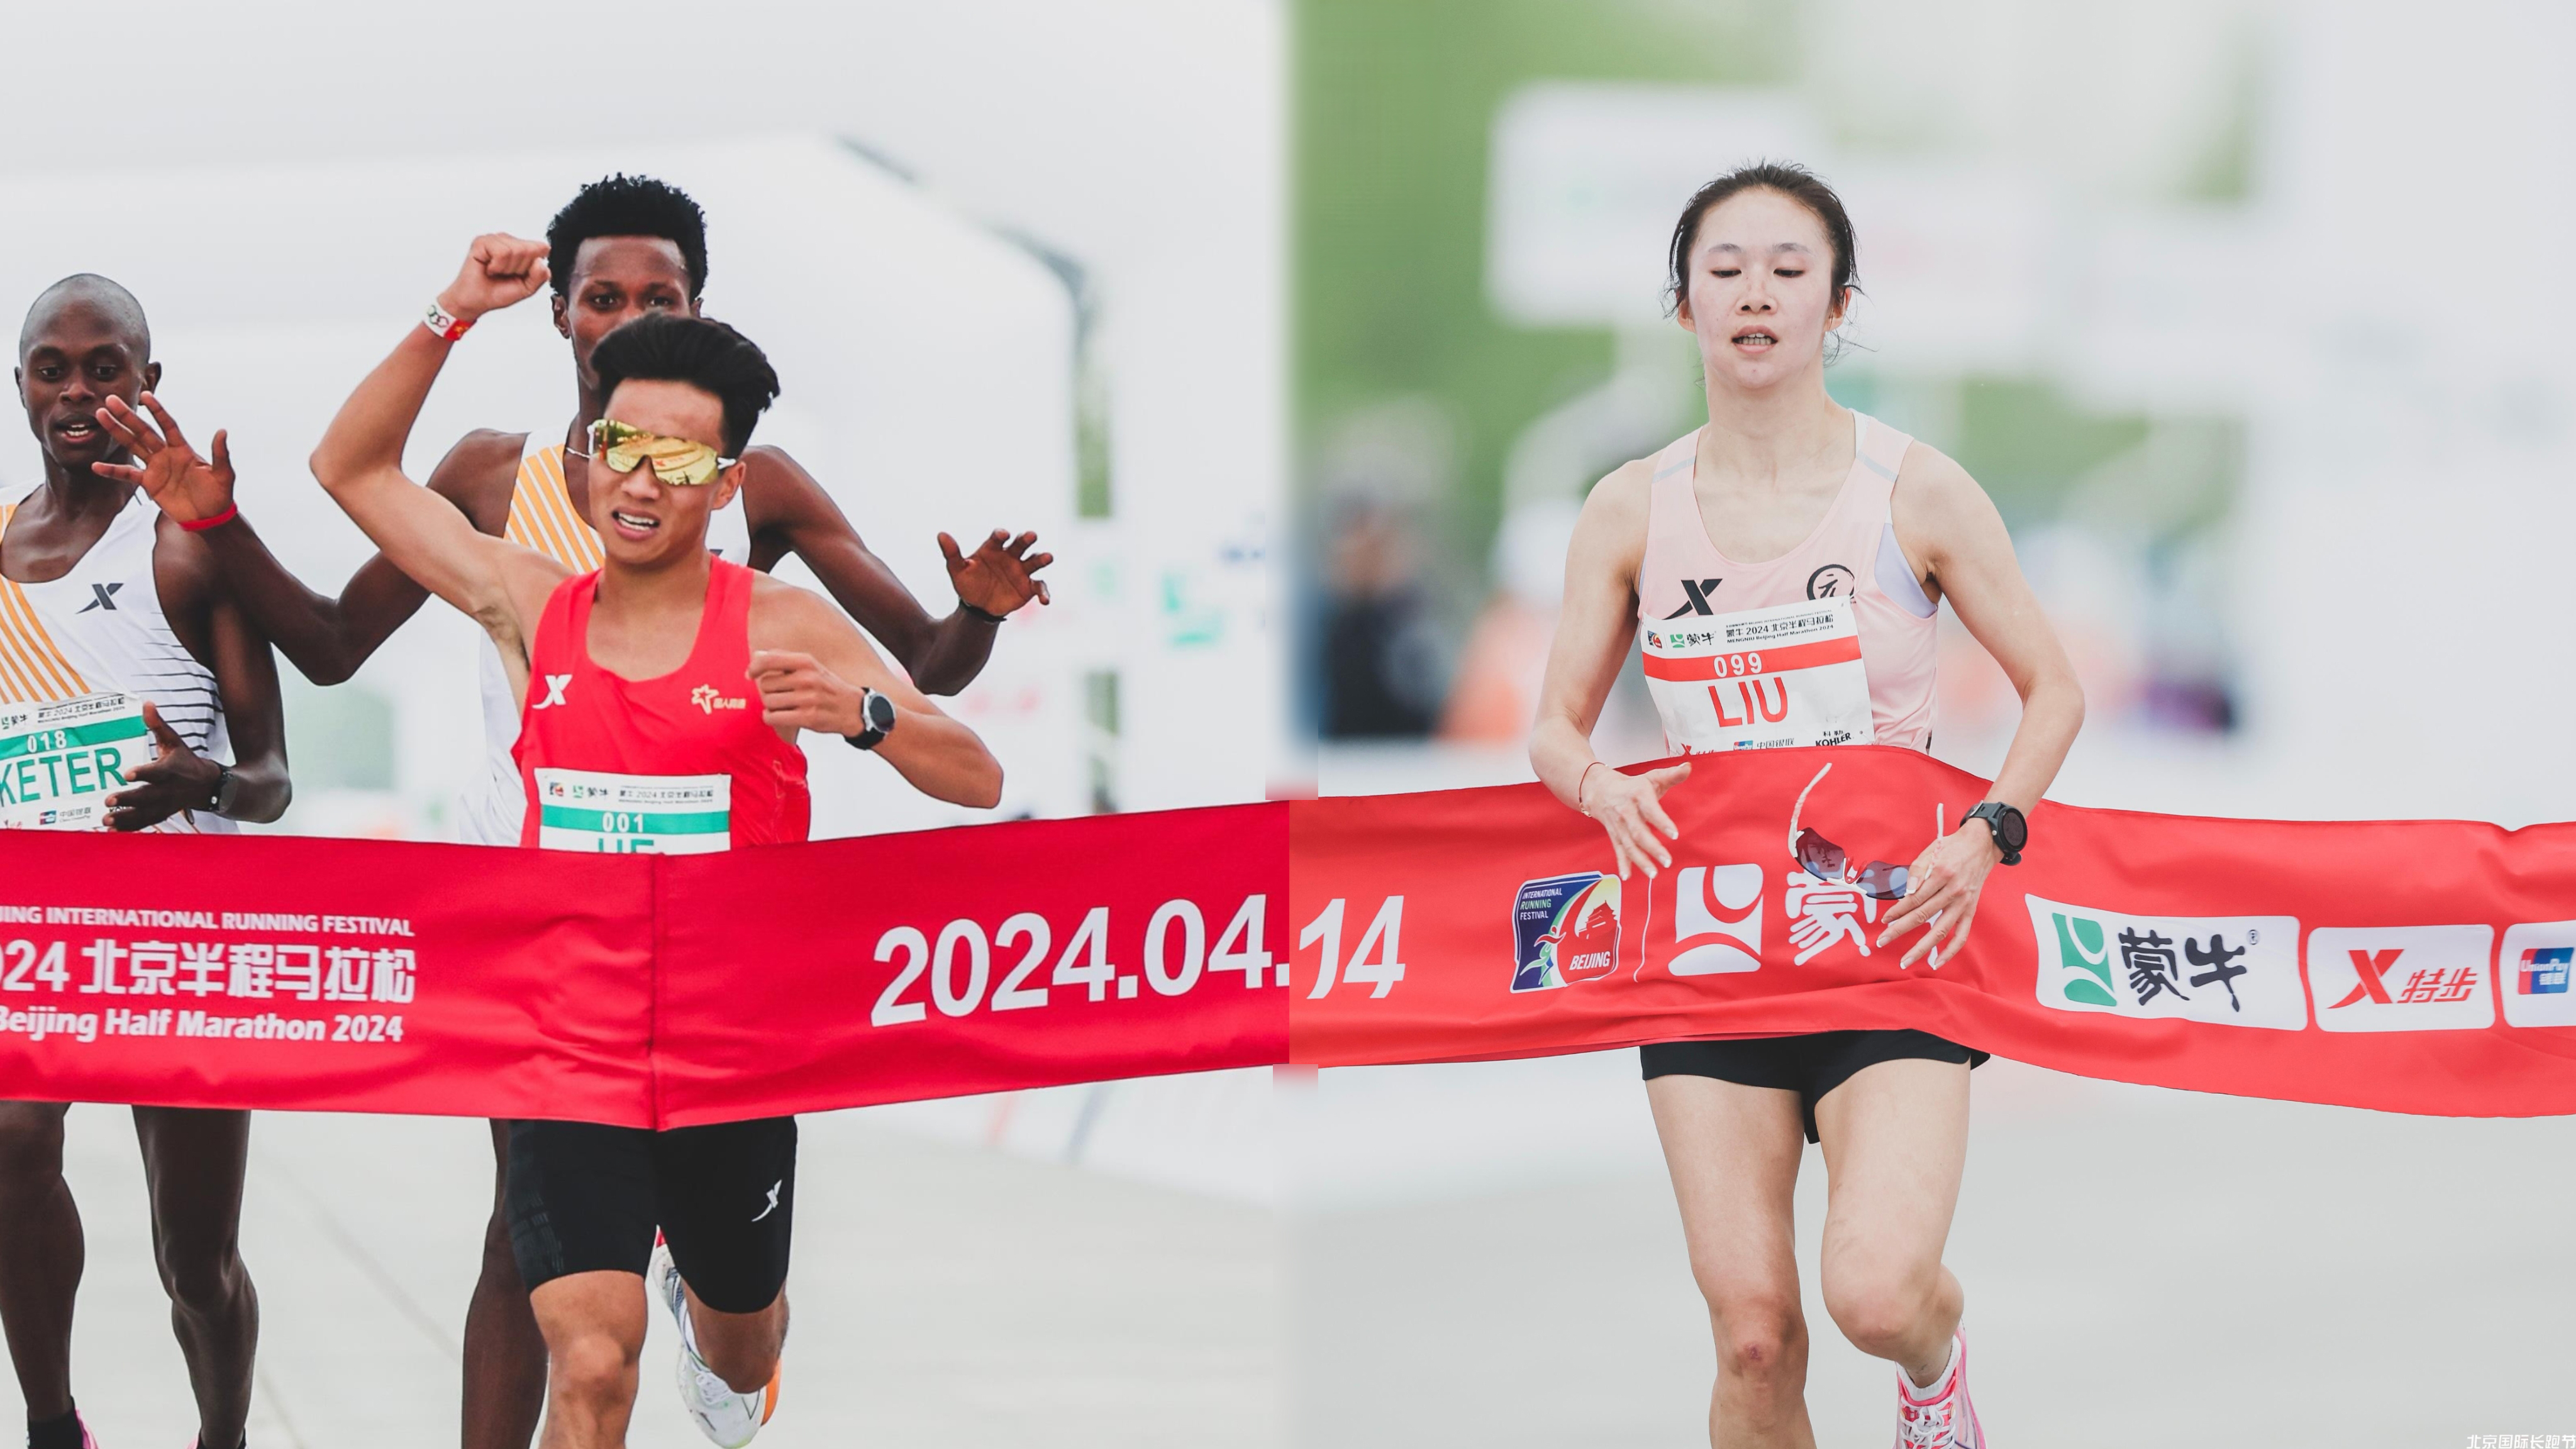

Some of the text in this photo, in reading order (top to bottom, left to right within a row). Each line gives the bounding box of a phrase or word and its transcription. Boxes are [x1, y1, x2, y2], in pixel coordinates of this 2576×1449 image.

[1746, 625, 1768, 635] 2024
[1790, 627, 1819, 635] Marathon
[1713, 652, 1762, 678] 099
[1707, 677, 1788, 728] LIU
[27, 730, 67, 753] 018
[1757, 737, 1794, 749] 中国银联
[1815, 732, 1852, 747] KOHLER
[0, 747, 128, 808] KETER
[602, 811, 644, 833] 001
[1522, 887, 1563, 899] INTERNATIONAL
[1520, 899, 1552, 910] RUNNING
[46, 906, 218, 929] INTERNATIONAL
[221, 912, 318, 932] RUNNING
[322, 915, 415, 936] FESTIVAL
[1519, 911, 1549, 921] FESTIVAL
[79, 938, 416, 1003] 北京半程马拉松
[1568, 951, 1611, 970] BEIJING
[2118, 927, 2246, 1012] 蒙牛
[2519, 958, 2570, 973] UnionPay
[104, 1008, 173, 1036] Half
[175, 1011, 325, 1041] Marathon
[331, 1014, 404, 1042] 2024
